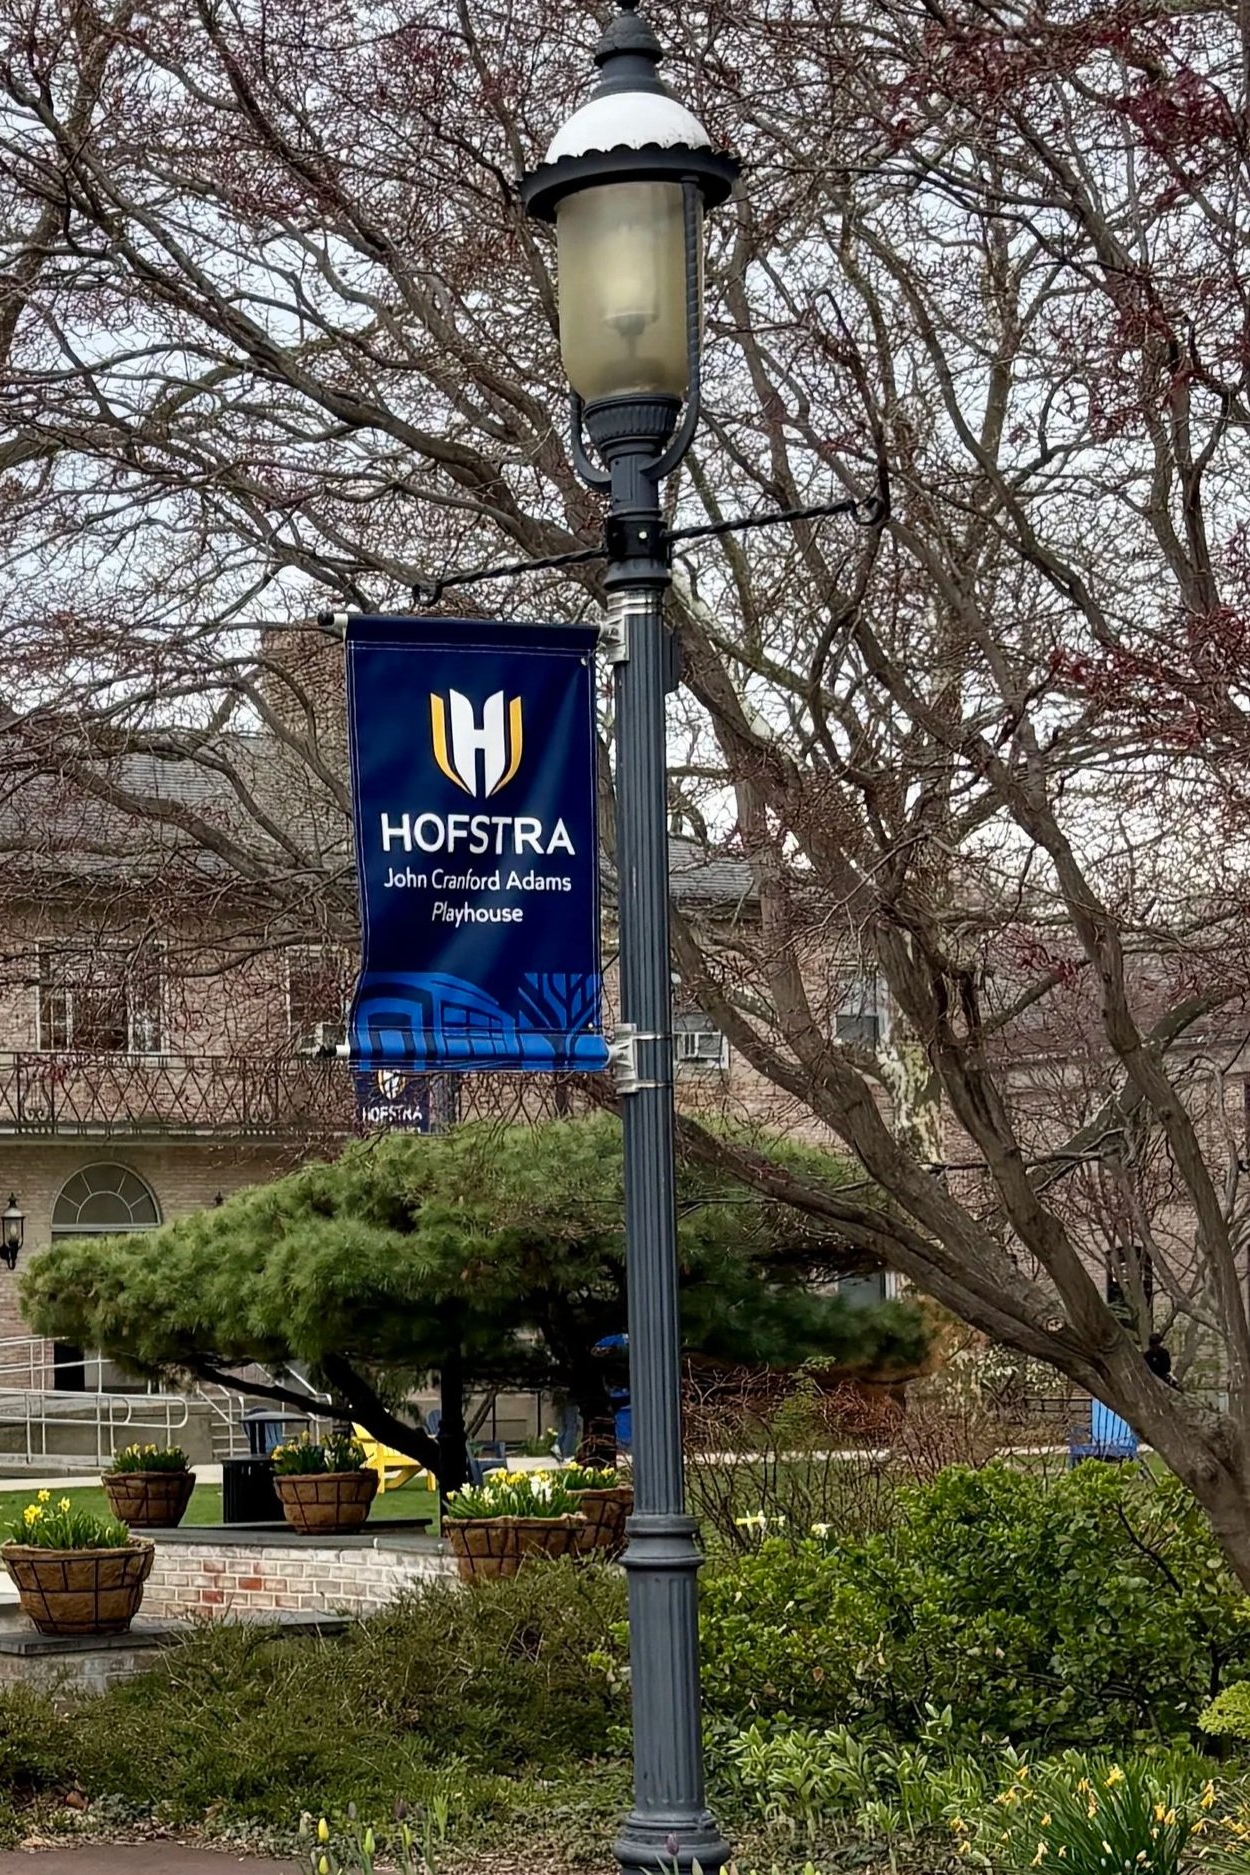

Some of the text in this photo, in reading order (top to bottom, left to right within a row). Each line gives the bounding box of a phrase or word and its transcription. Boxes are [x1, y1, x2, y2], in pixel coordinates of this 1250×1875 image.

[380, 813, 576, 855] HOFSTRA
[384, 866, 572, 892] John Cranford Adams
[432, 901, 524, 928] Playhouse
